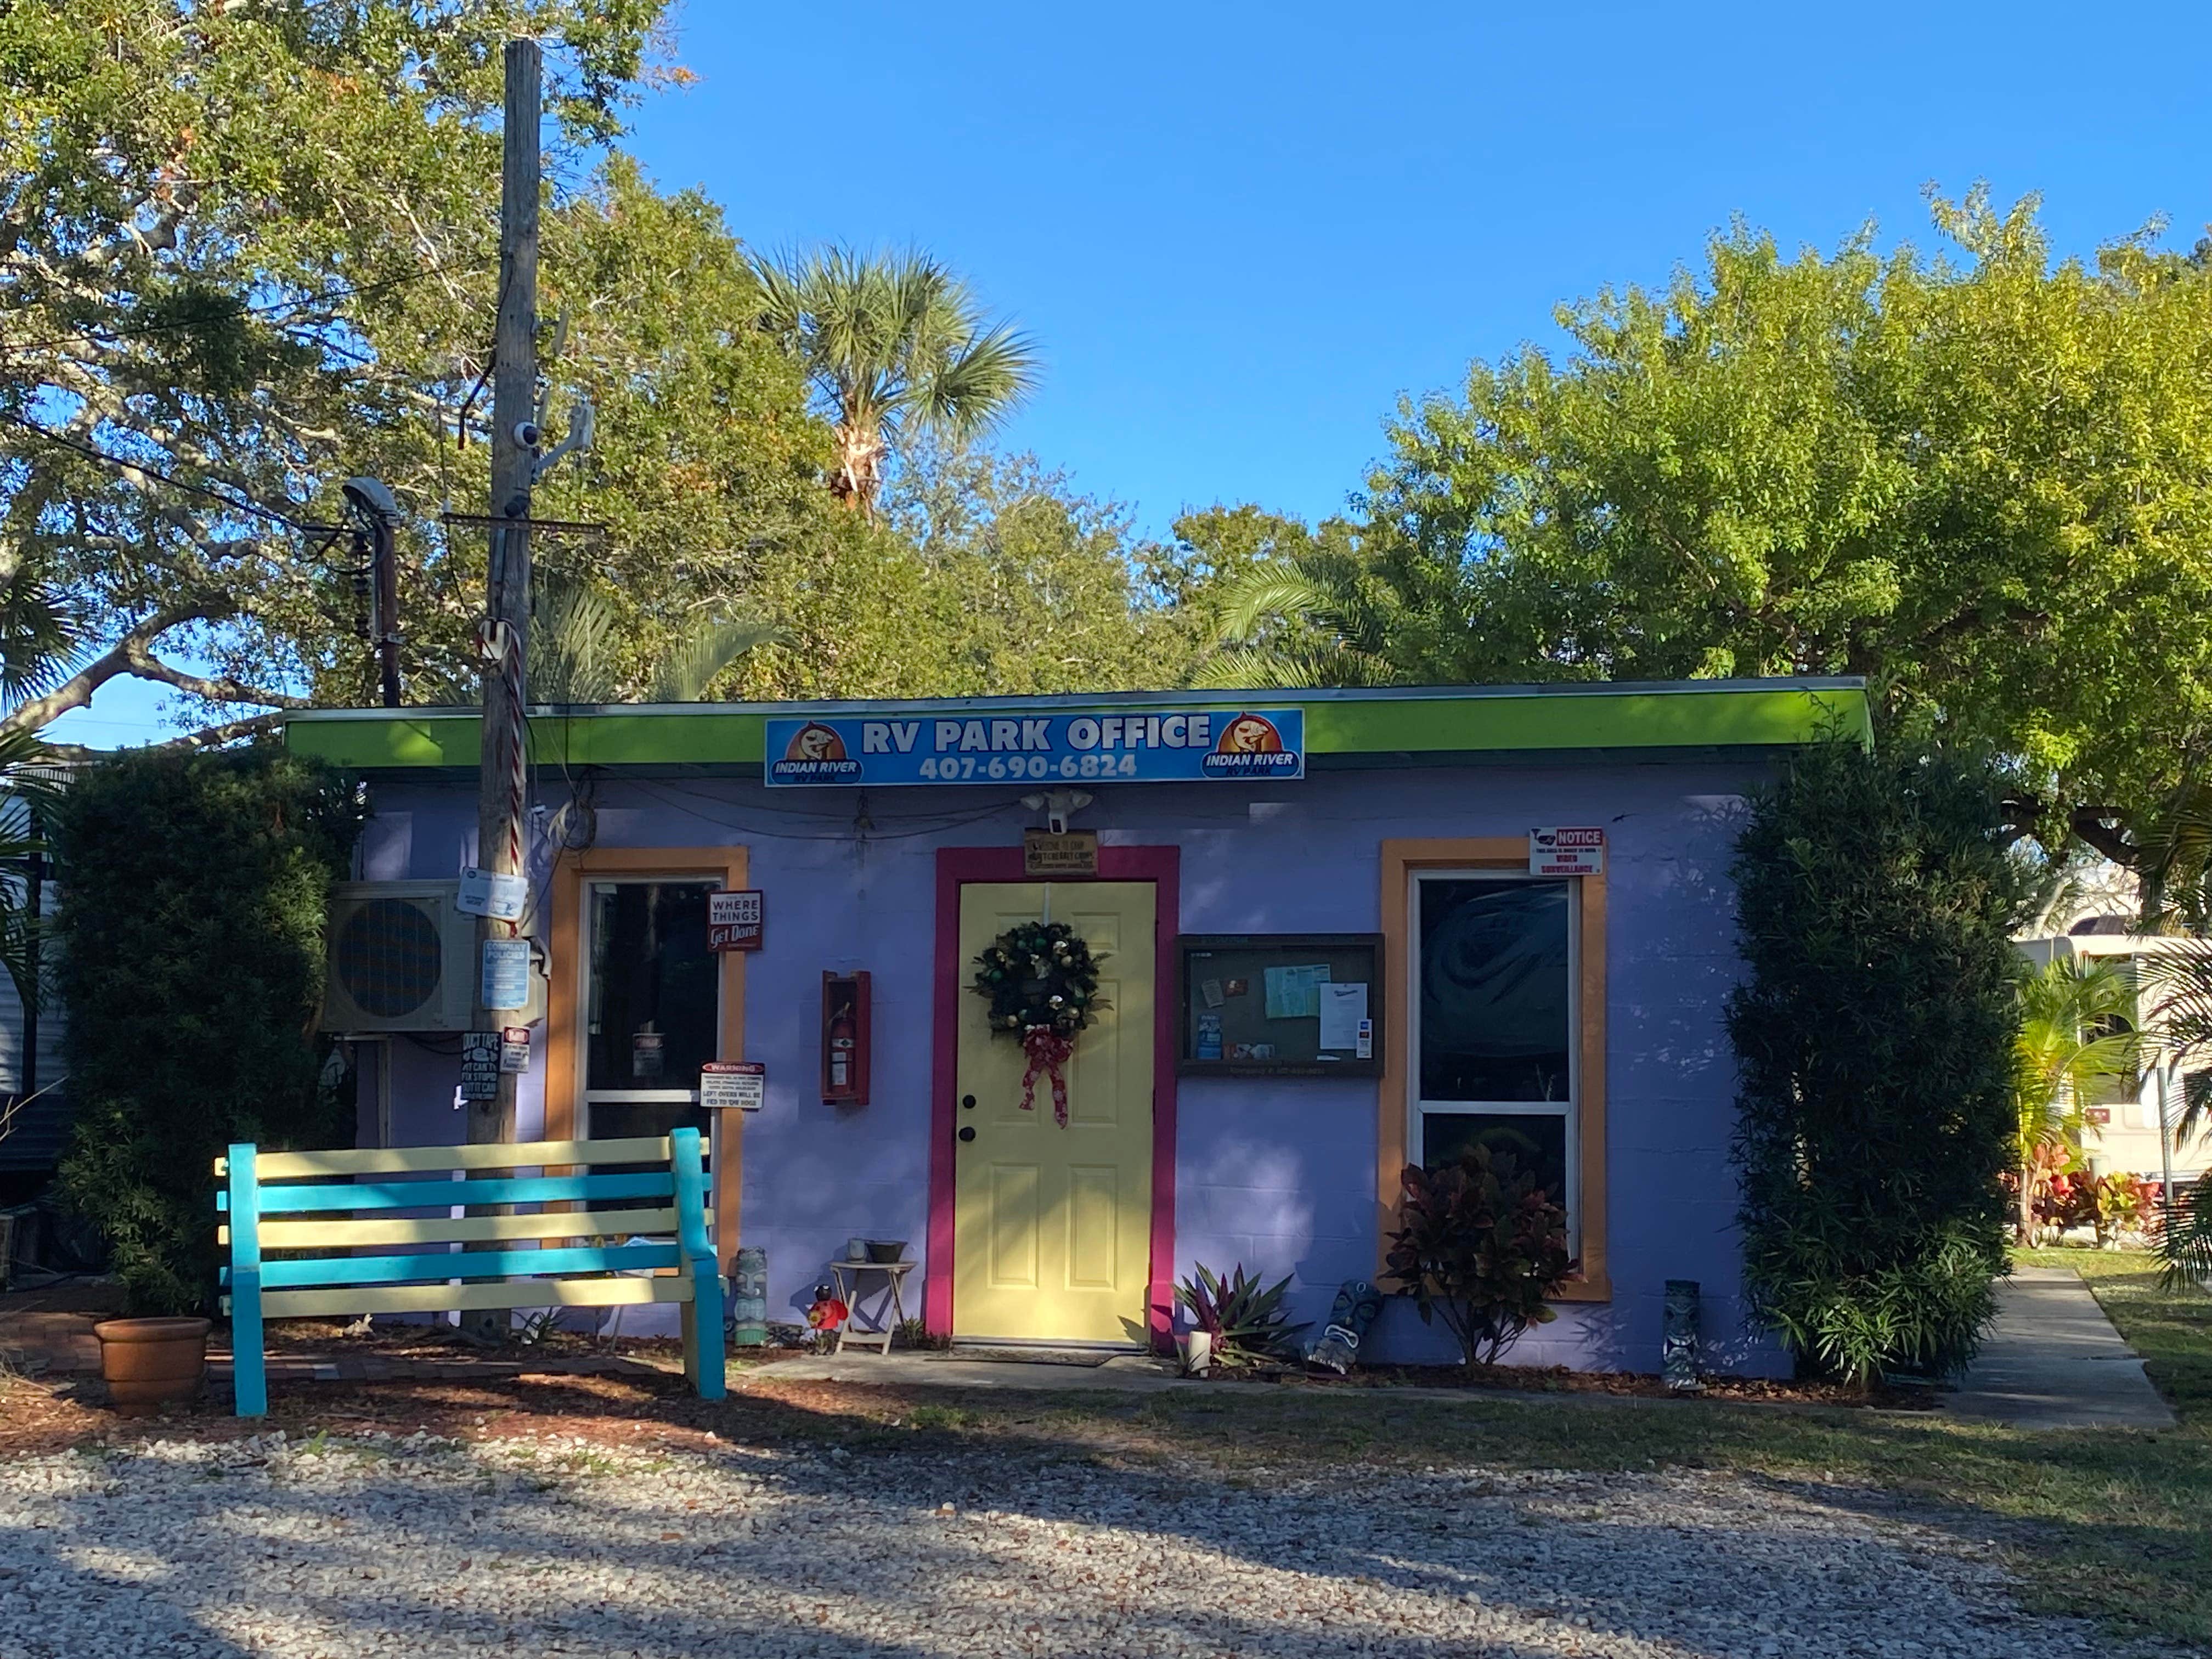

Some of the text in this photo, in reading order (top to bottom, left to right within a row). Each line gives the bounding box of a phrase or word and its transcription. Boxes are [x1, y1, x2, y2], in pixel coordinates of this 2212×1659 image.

[863, 713, 1211, 753] RV PARK OFFICE
[1206, 753, 1293, 766] INDIAN RIVER
[775, 761, 856, 772] INDIAN RIVER
[919, 754, 1137, 780] 407-690-6824
[1558, 831, 1600, 844] NOTICE
[713, 900, 758, 910] WHERE
[713, 911, 758, 922] THINGS
